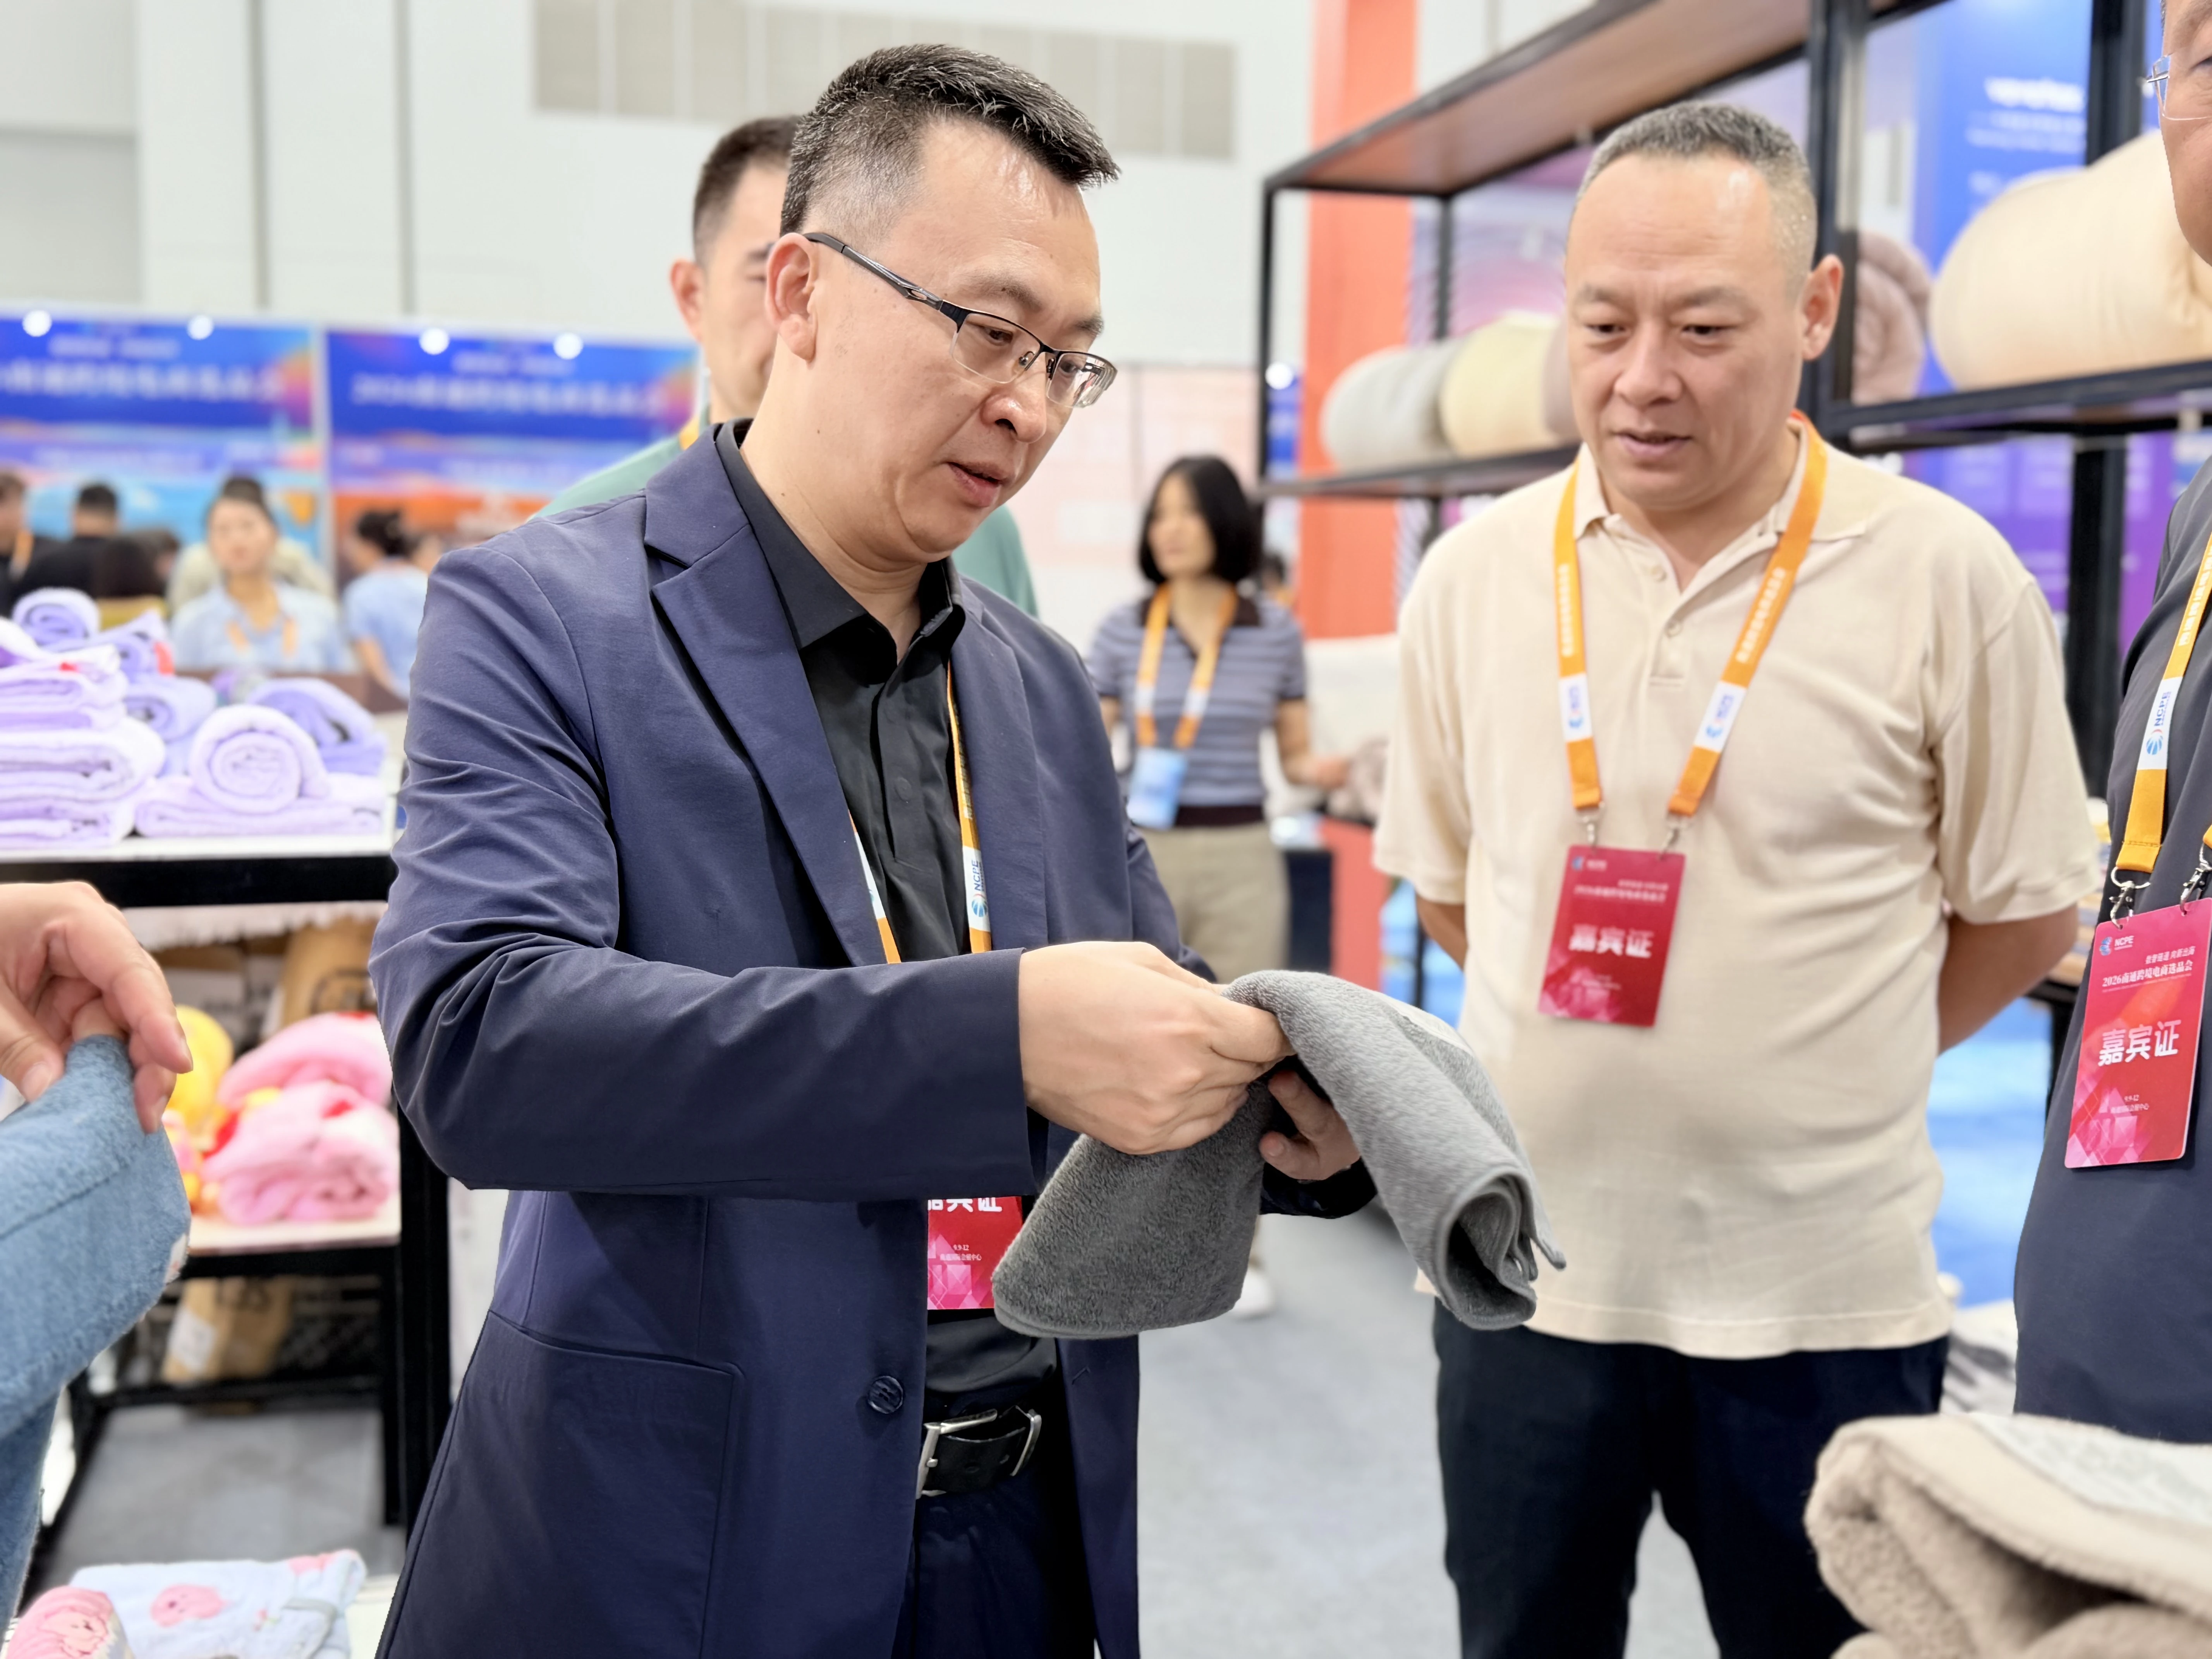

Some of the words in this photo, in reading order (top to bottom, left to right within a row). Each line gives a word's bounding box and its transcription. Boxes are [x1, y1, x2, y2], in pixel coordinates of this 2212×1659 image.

[971, 860, 980, 891] NCPE
[1569, 923, 1654, 958] 嘉宾证
[2114, 935, 2134, 946] NCPE
[2102, 960, 2193, 987] 2026南通跨境电商选品会
[2098, 1019, 2181, 1066] 嘉宾证
